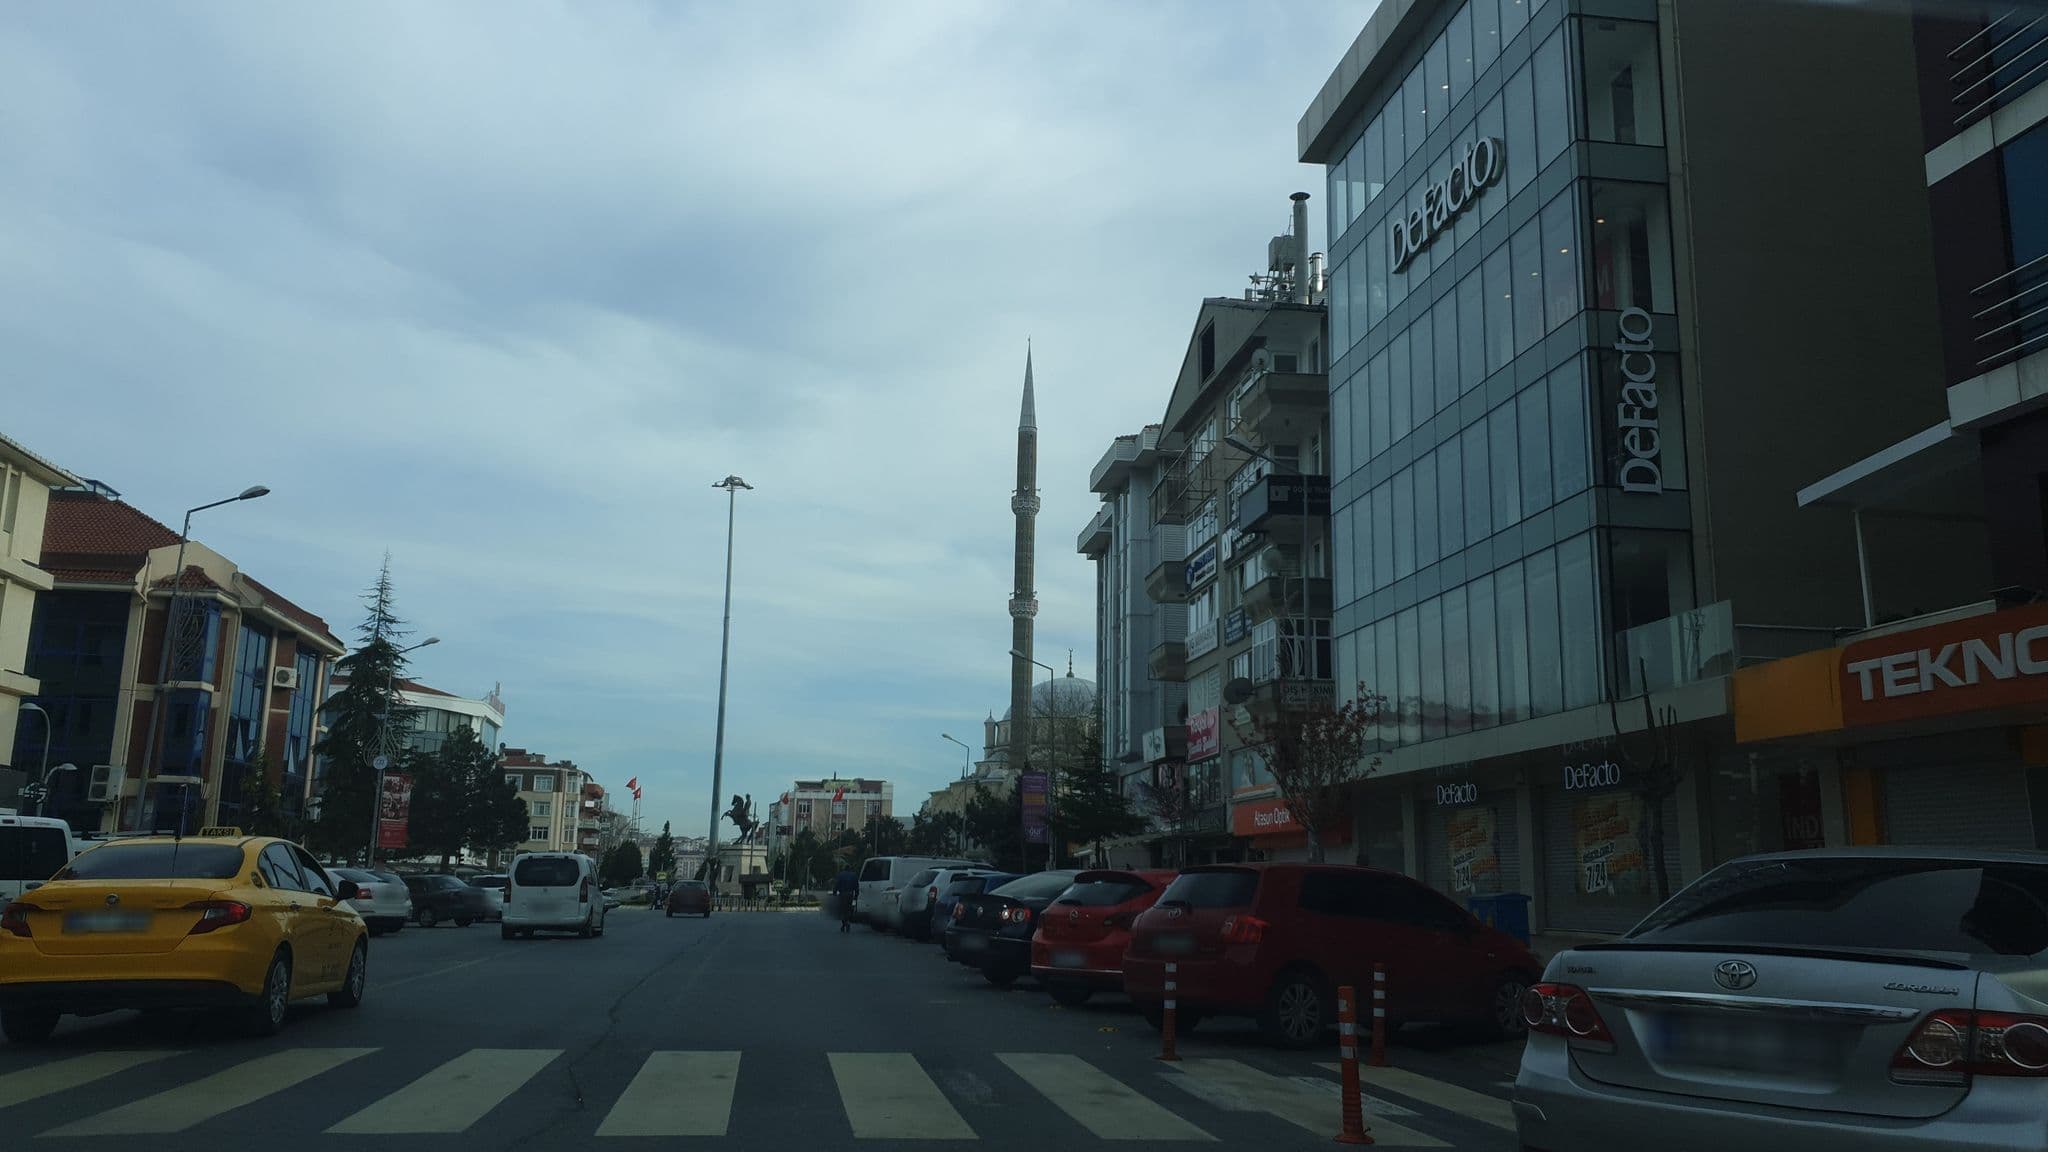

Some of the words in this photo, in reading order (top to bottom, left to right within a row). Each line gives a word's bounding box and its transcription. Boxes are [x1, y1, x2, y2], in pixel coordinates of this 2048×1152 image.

[1390, 135, 1505, 275] DeFacto
[1612, 305, 1663, 495] DeFacto
[1437, 783, 1477, 805] DeFacto
[1564, 760, 1621, 790] DeFacto
